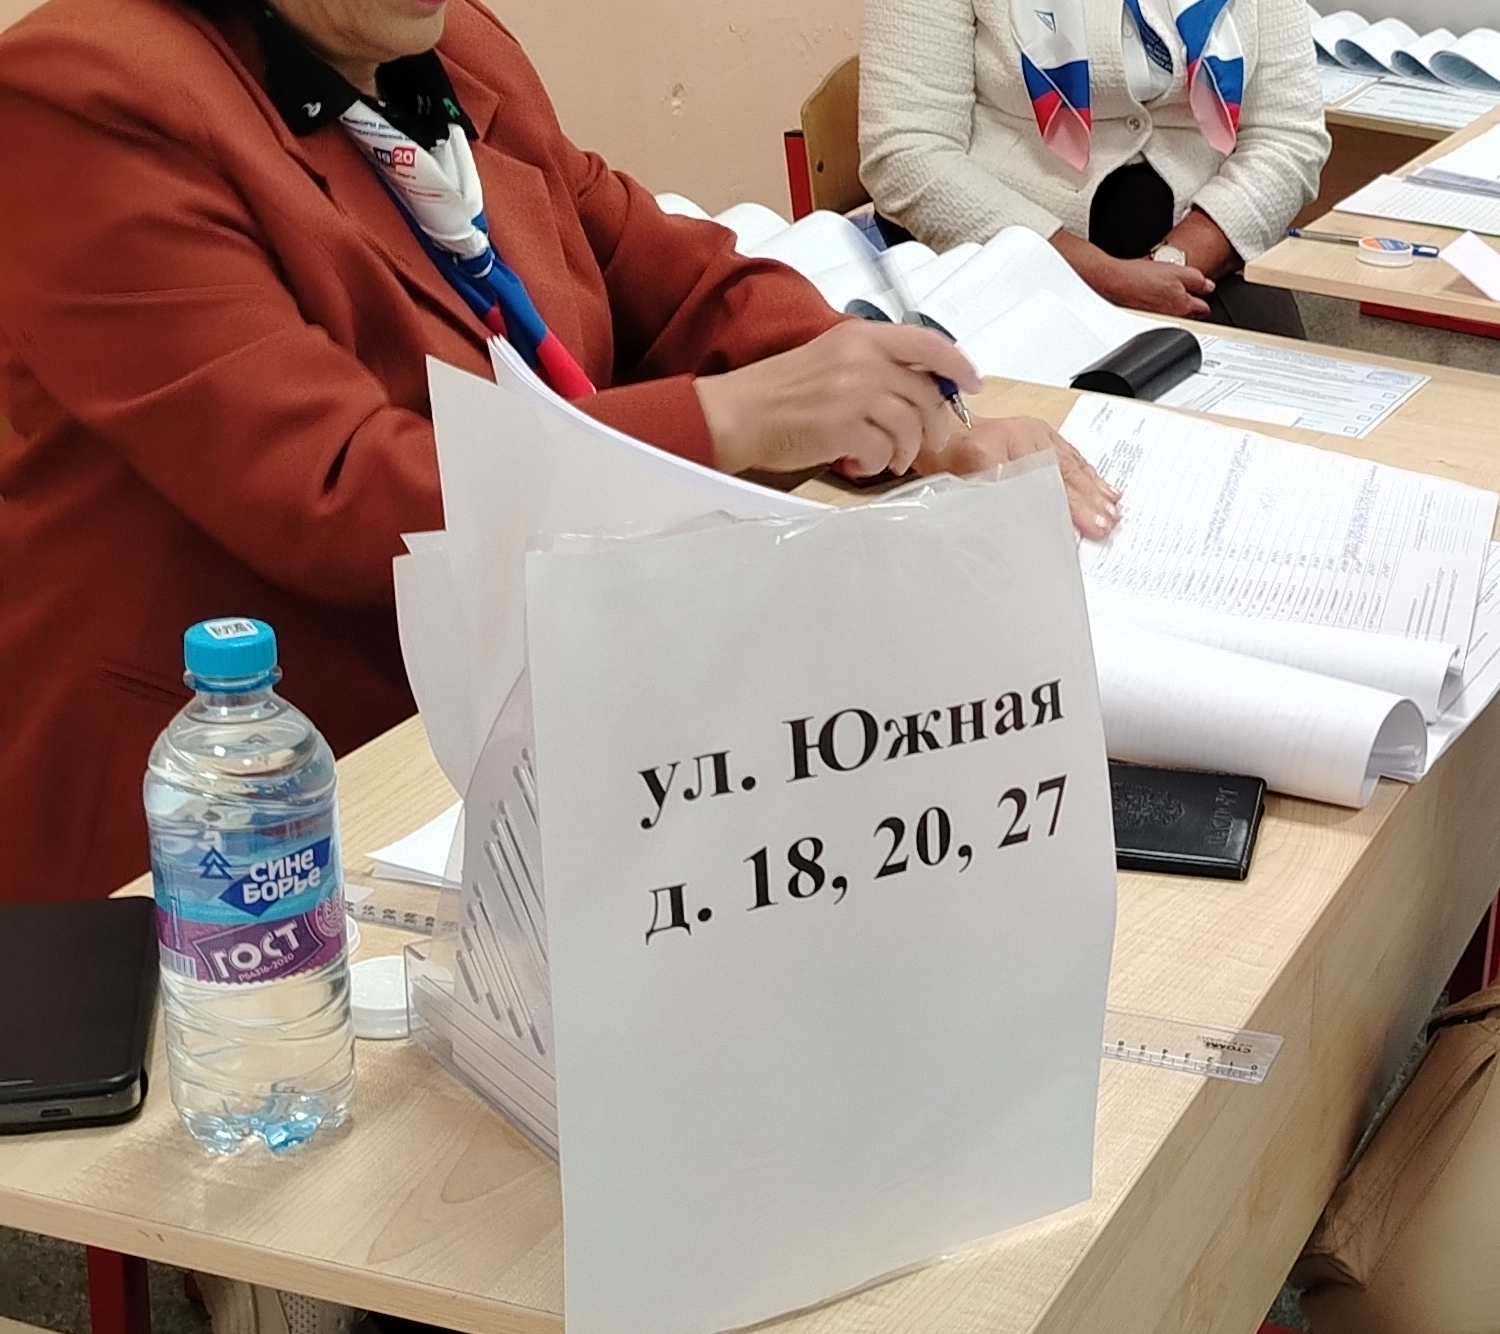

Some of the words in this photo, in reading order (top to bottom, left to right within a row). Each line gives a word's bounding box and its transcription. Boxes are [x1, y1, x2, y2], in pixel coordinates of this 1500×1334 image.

[394, 150, 414, 165] 20
[638, 749, 757, 829] ул.
[783, 679, 1065, 781] Южная
[645, 883, 713, 945] д.
[744, 836, 848, 910] 18,
[873, 806, 973, 880] 20,
[998, 774, 1069, 849] 27
[213, 921, 300, 979] ГОСТ
